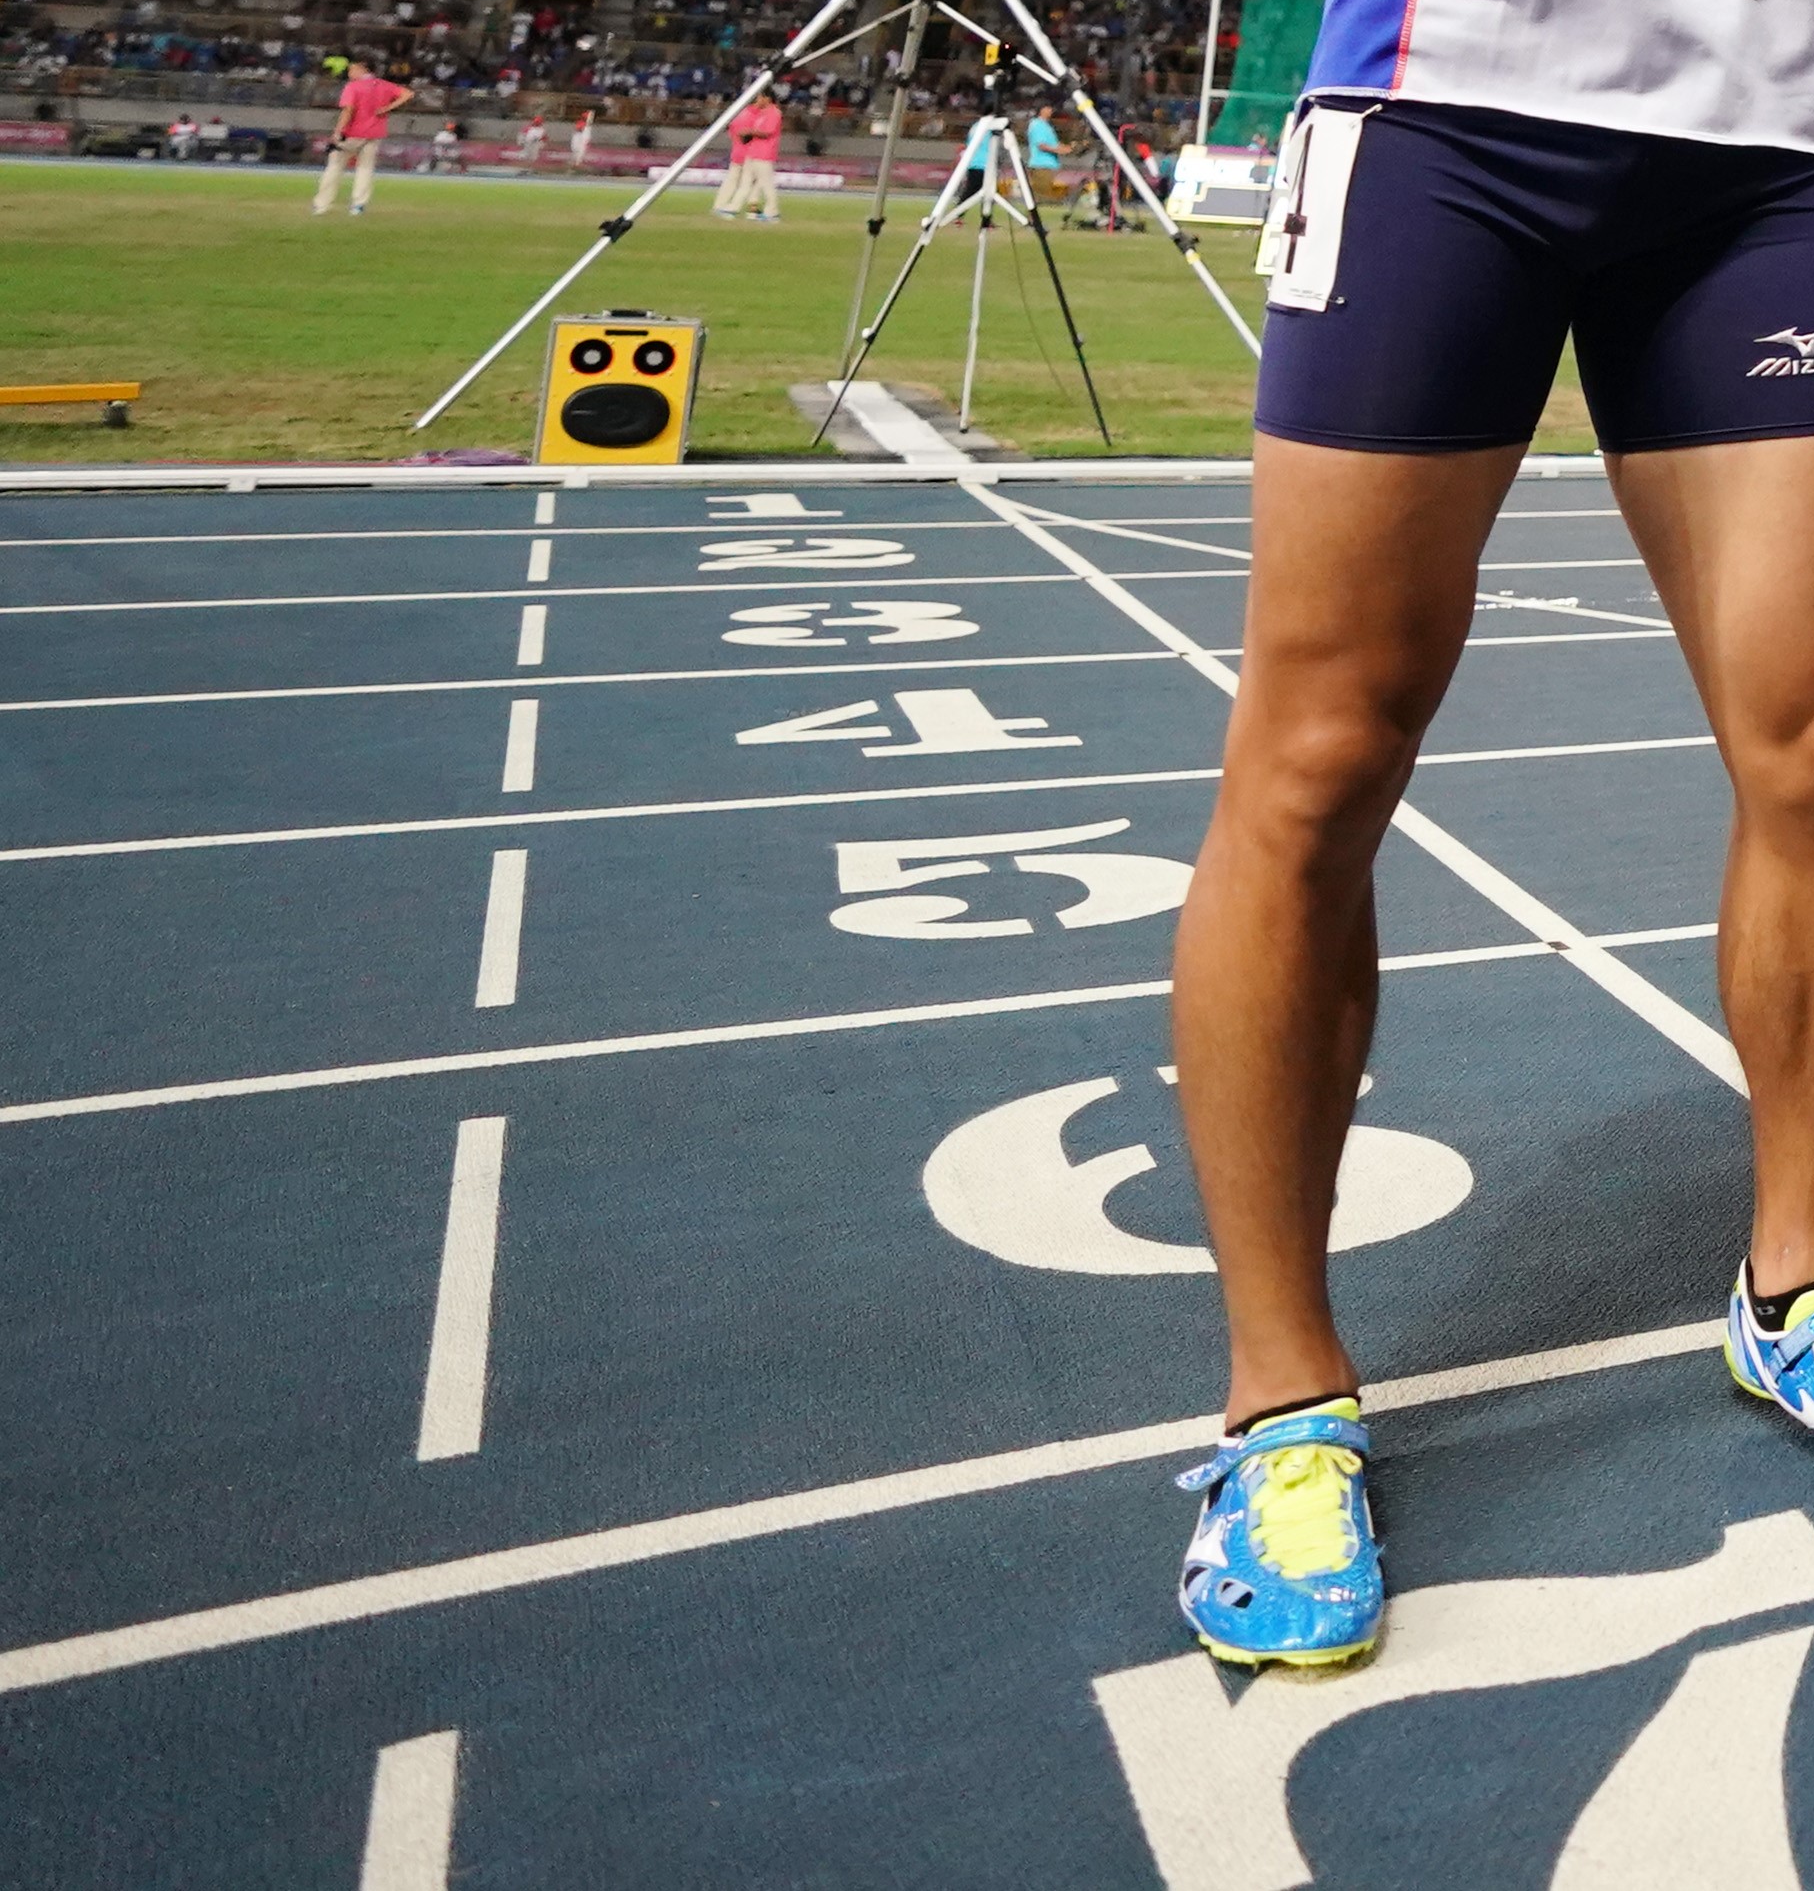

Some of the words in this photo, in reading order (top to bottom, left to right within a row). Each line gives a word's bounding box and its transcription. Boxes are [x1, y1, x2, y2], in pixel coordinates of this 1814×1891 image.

[705, 493, 844, 519] 1
[697, 537, 916, 572] 2
[720, 600, 981, 647] 3
[735, 687, 1084, 758] 4
[828, 817, 1197, 940] 5
[922, 1065, 1475, 1276] 6
